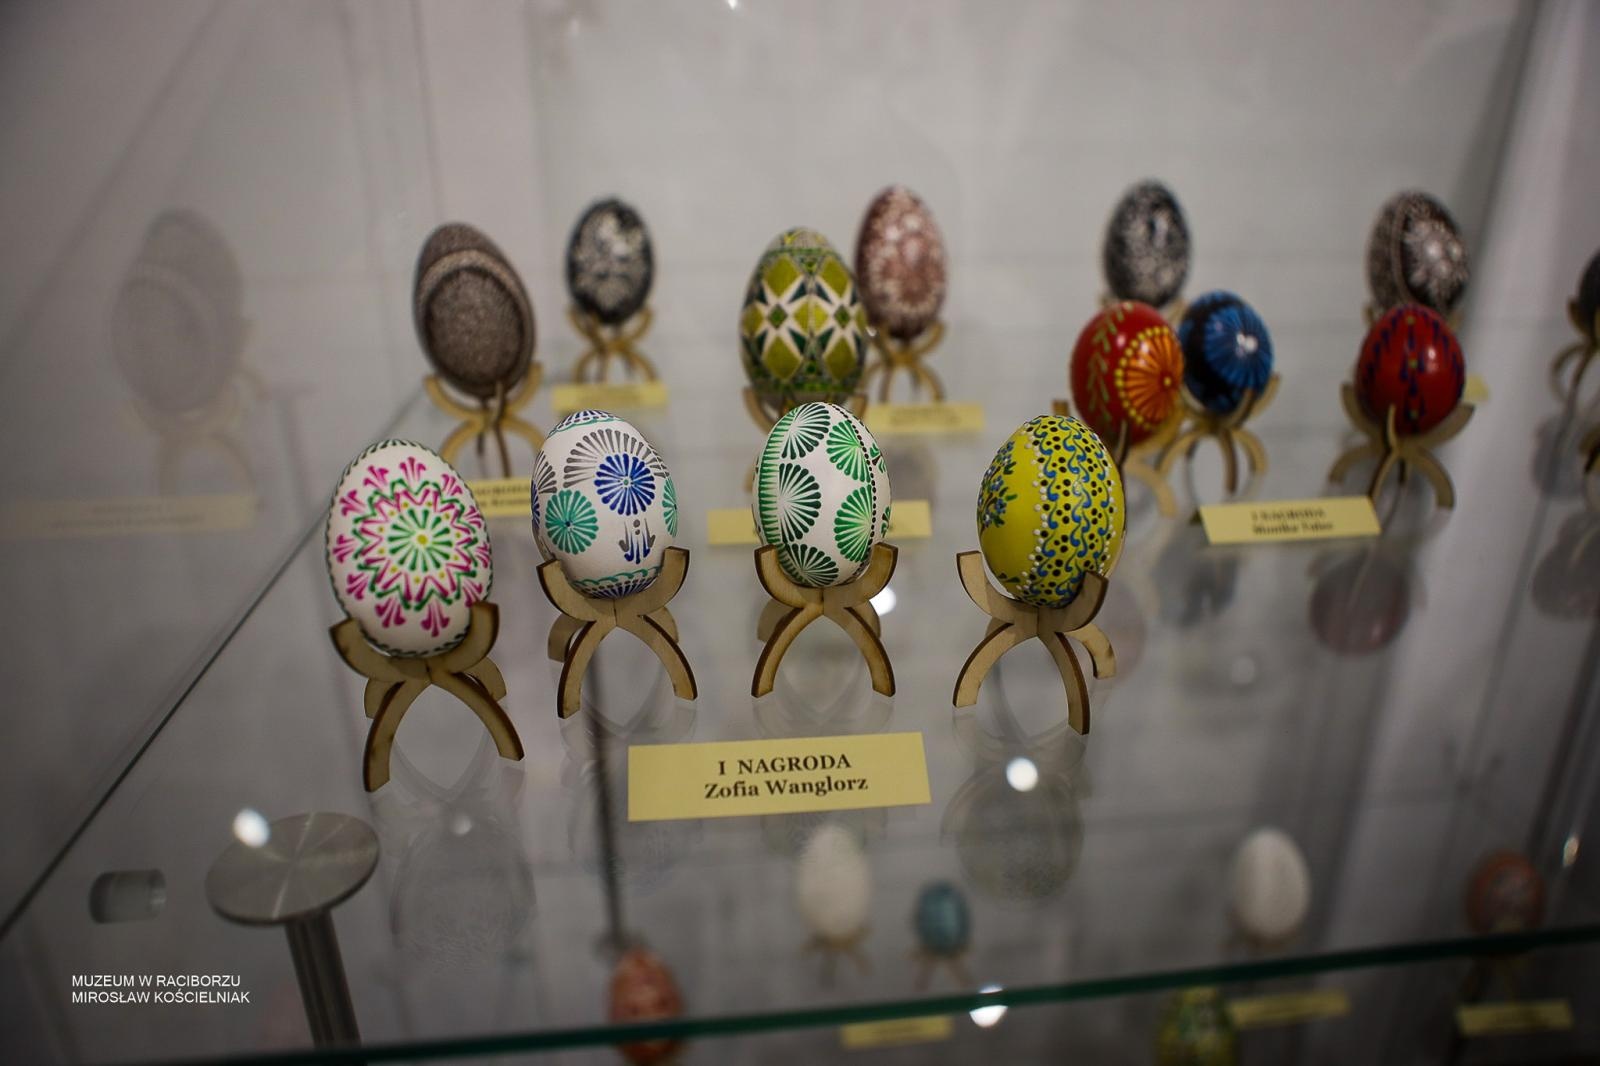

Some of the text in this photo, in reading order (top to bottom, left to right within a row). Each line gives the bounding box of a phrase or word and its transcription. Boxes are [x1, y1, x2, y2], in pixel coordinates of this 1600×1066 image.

[718, 753, 852, 775] I NAGRODA
[705, 775, 868, 799] Zofia Wanglorz
